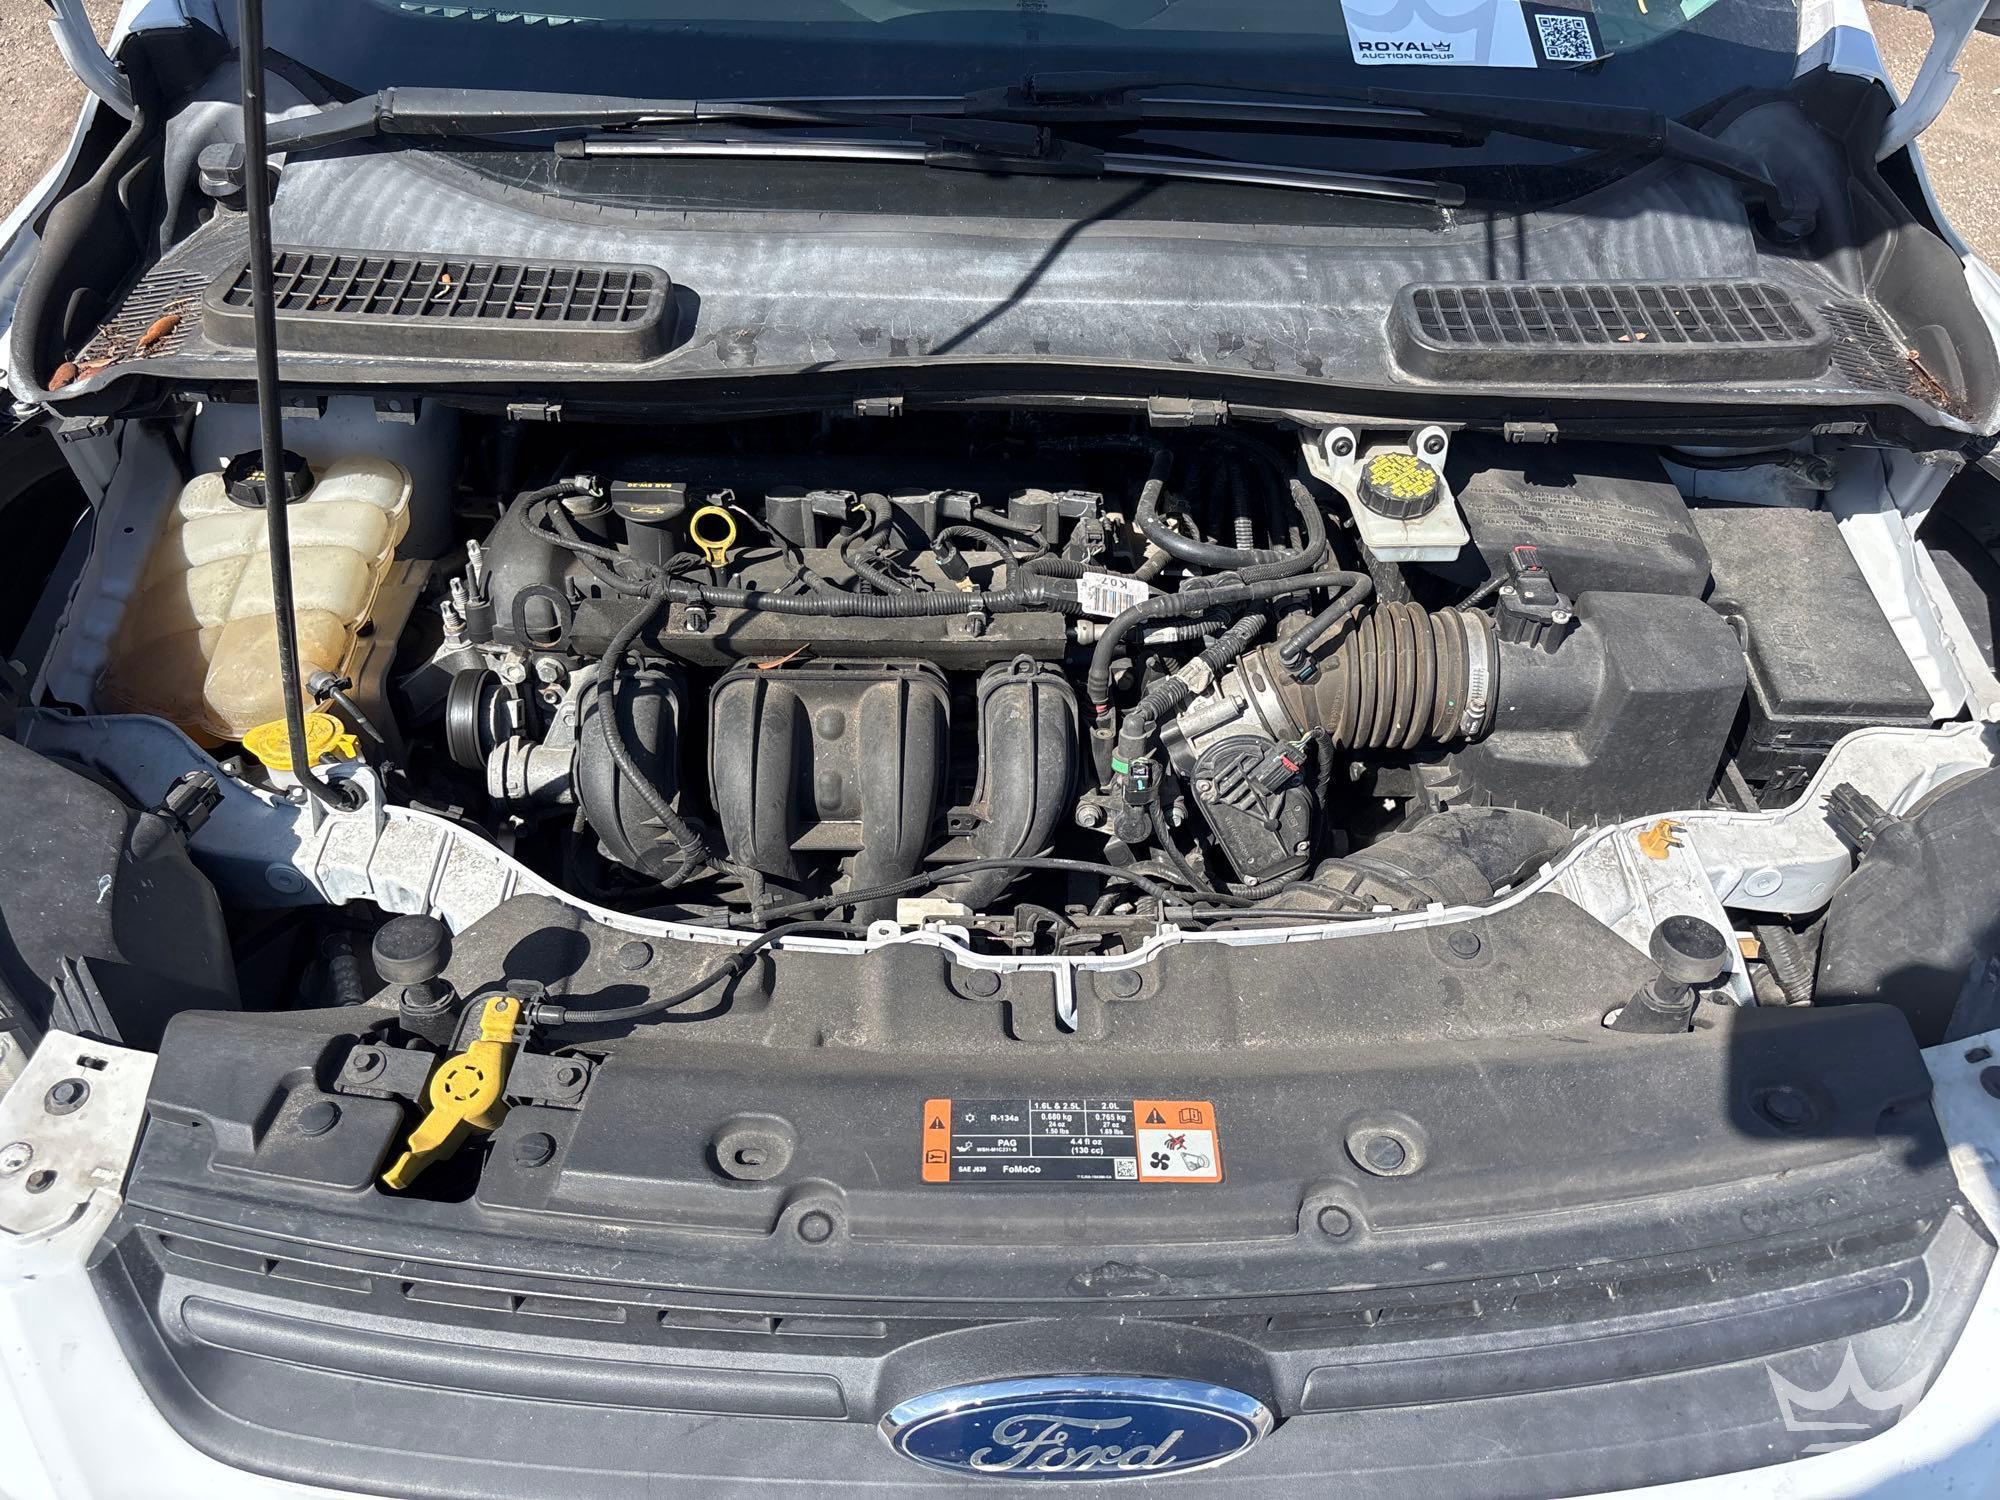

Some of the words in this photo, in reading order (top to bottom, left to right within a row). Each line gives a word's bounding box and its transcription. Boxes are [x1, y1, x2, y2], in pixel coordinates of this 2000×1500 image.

[1358, 42, 1433, 51] ROYAL
[1101, 577, 1127, 589] K07
[1062, 1114, 1072, 1122] kg
[1117, 1114, 1126, 1122] kg
[970, 1413, 1184, 1472] Ford
